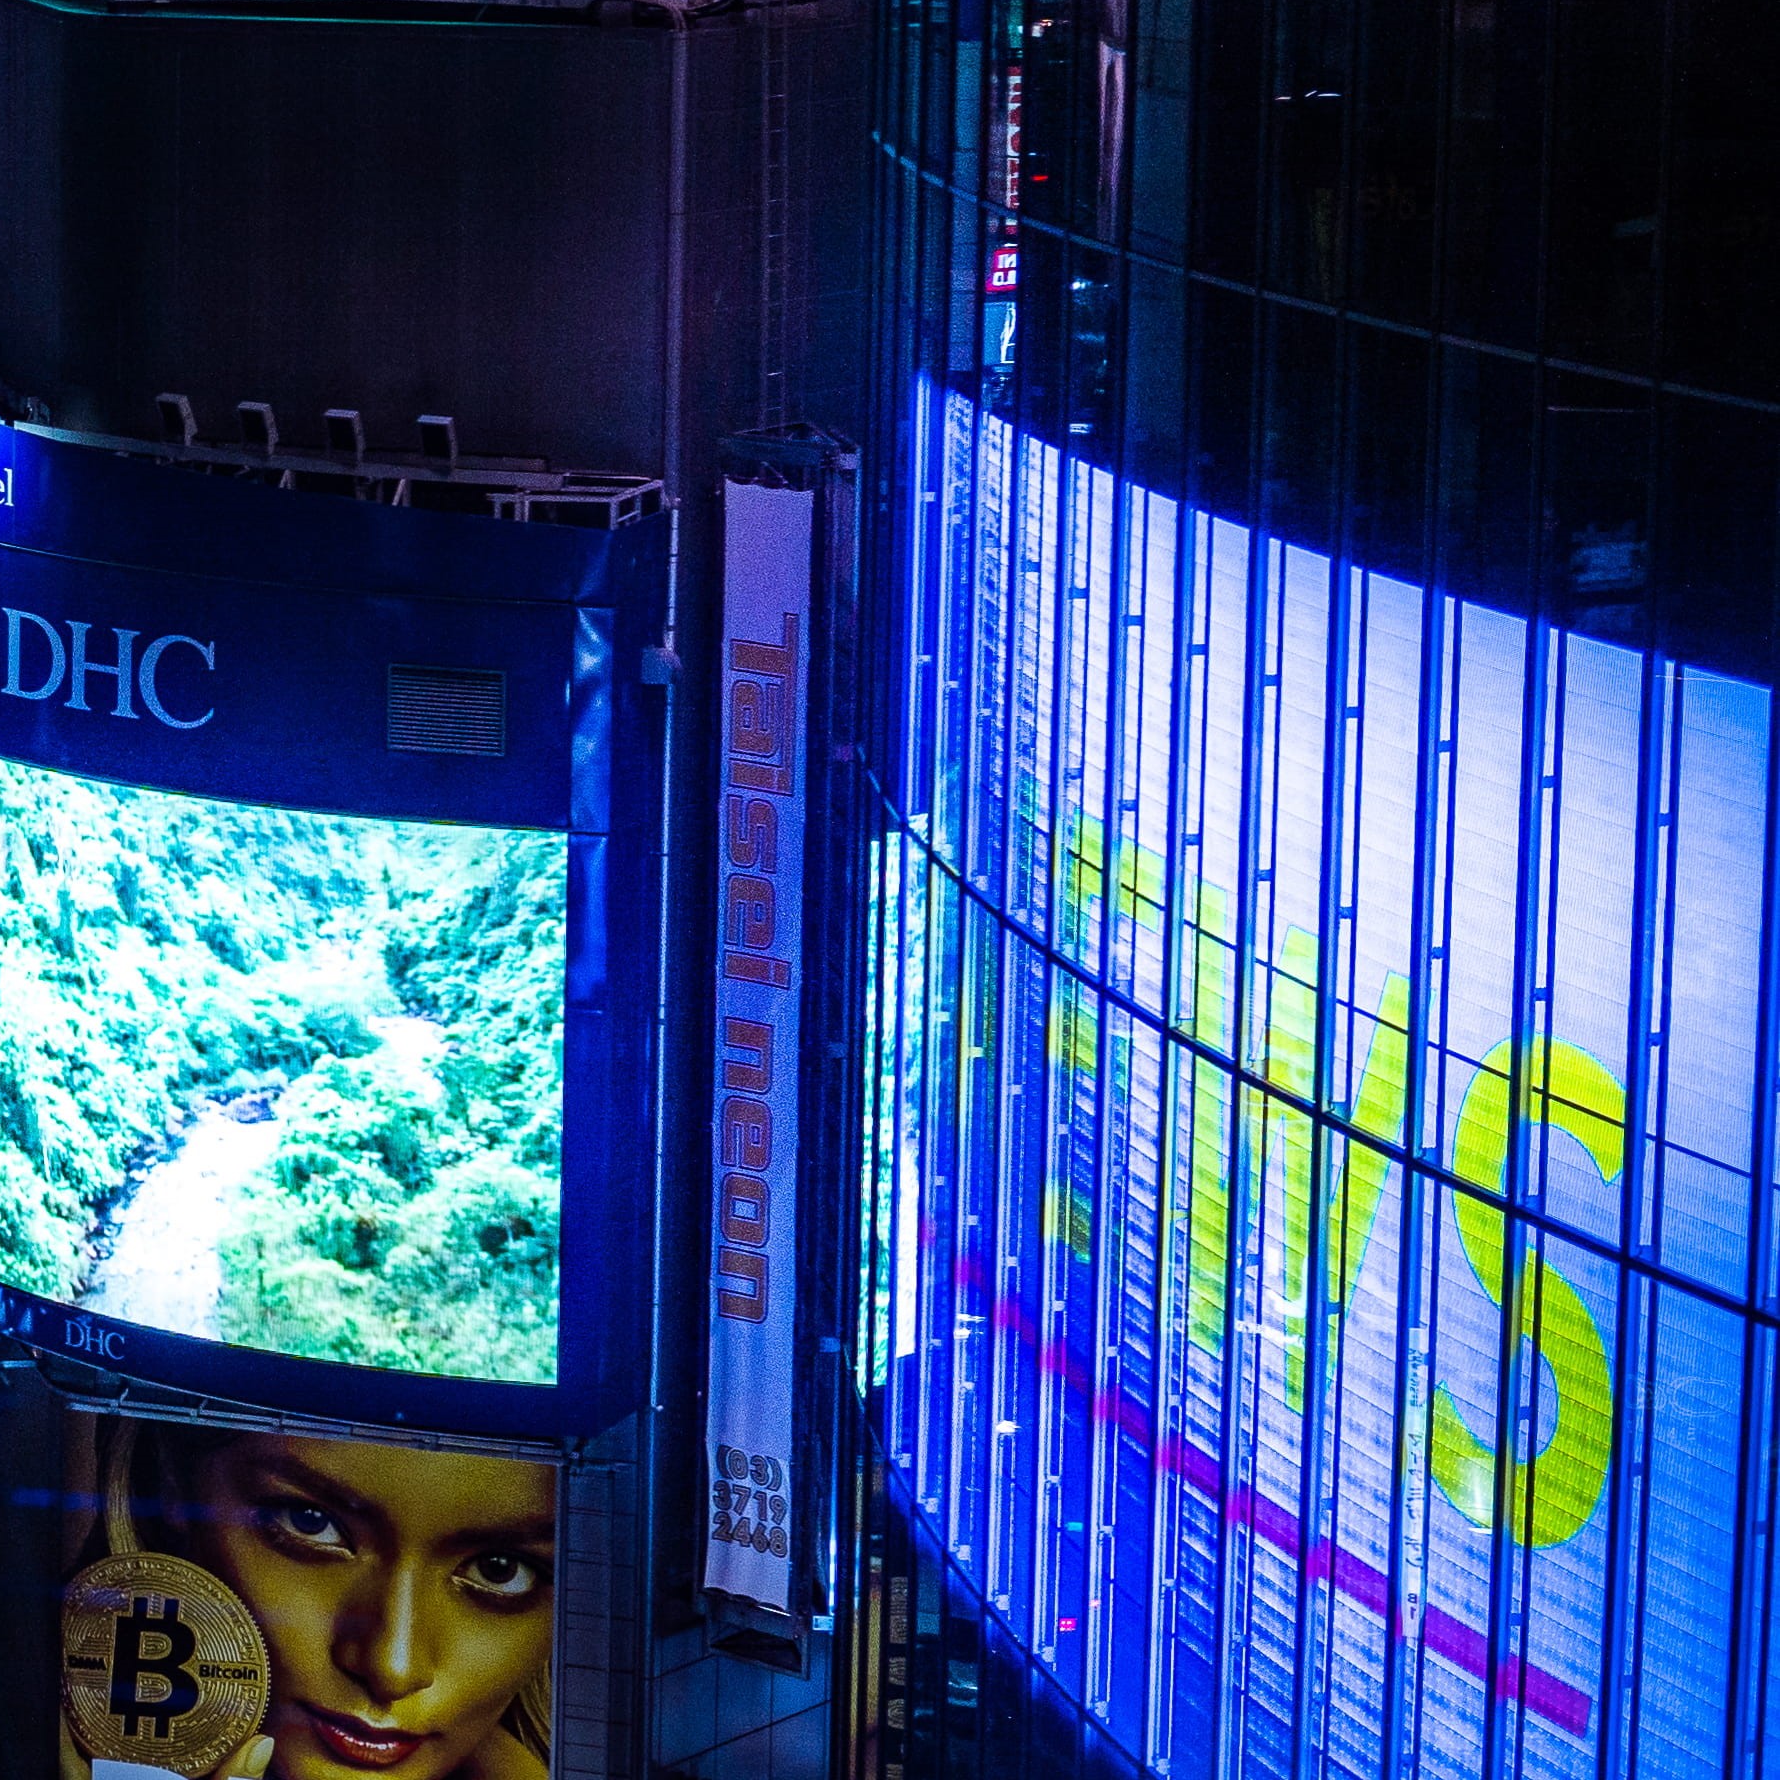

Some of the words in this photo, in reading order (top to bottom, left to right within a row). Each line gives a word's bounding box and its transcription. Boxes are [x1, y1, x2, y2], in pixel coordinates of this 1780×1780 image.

[1, 606, 216, 731] DHC
[722, 613, 800, 990] Taisei
[717, 1018, 778, 1327] neon
[64, 1320, 126, 1361] DHC
[714, 1444, 782, 1490] (03)
[712, 1478, 789, 1526] 3719
[710, 1514, 789, 1560] 2468
[198, 1663, 259, 1683] Bitcoin
